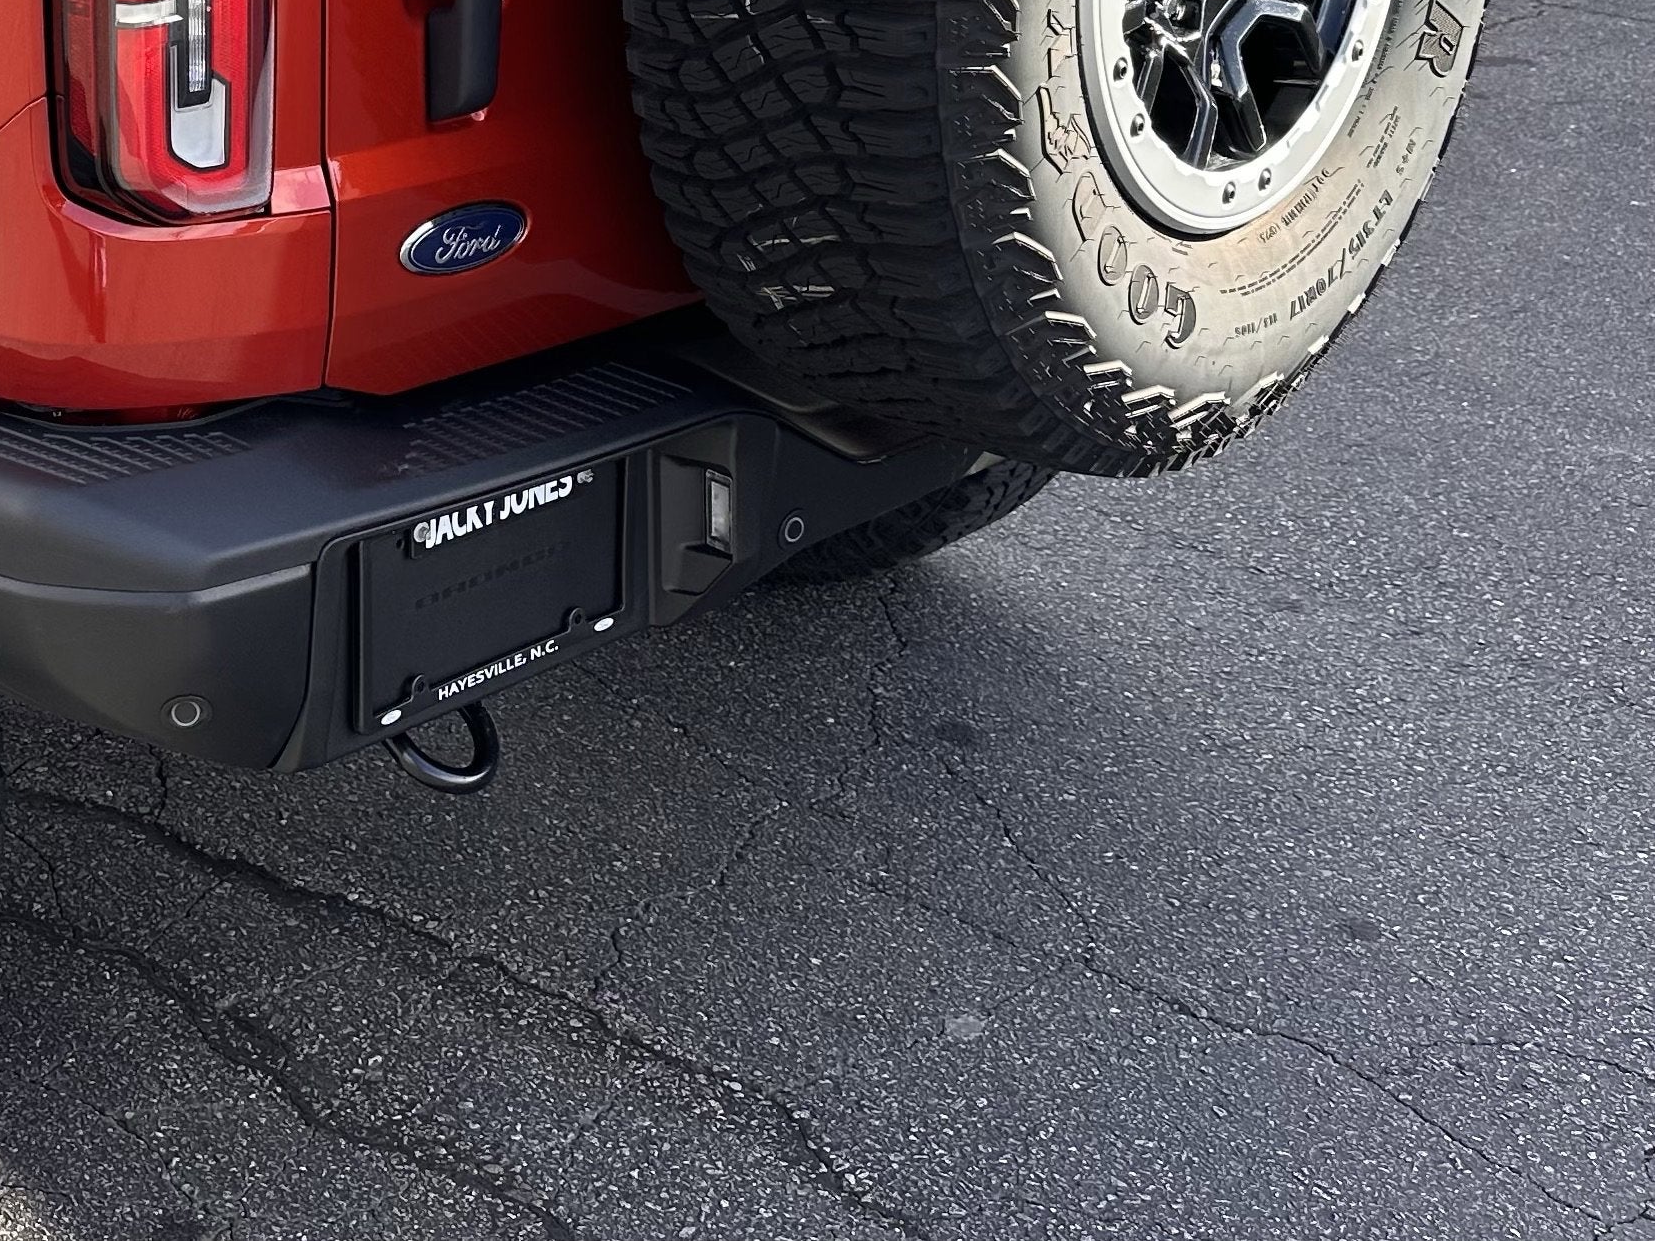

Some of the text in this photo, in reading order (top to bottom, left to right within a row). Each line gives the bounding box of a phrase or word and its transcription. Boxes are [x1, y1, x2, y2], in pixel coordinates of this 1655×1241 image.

[434, 222, 502, 265] Ford
[426, 500, 496, 549] JACKY
[438, 640, 559, 701] HAYESVILLE, N.C.
